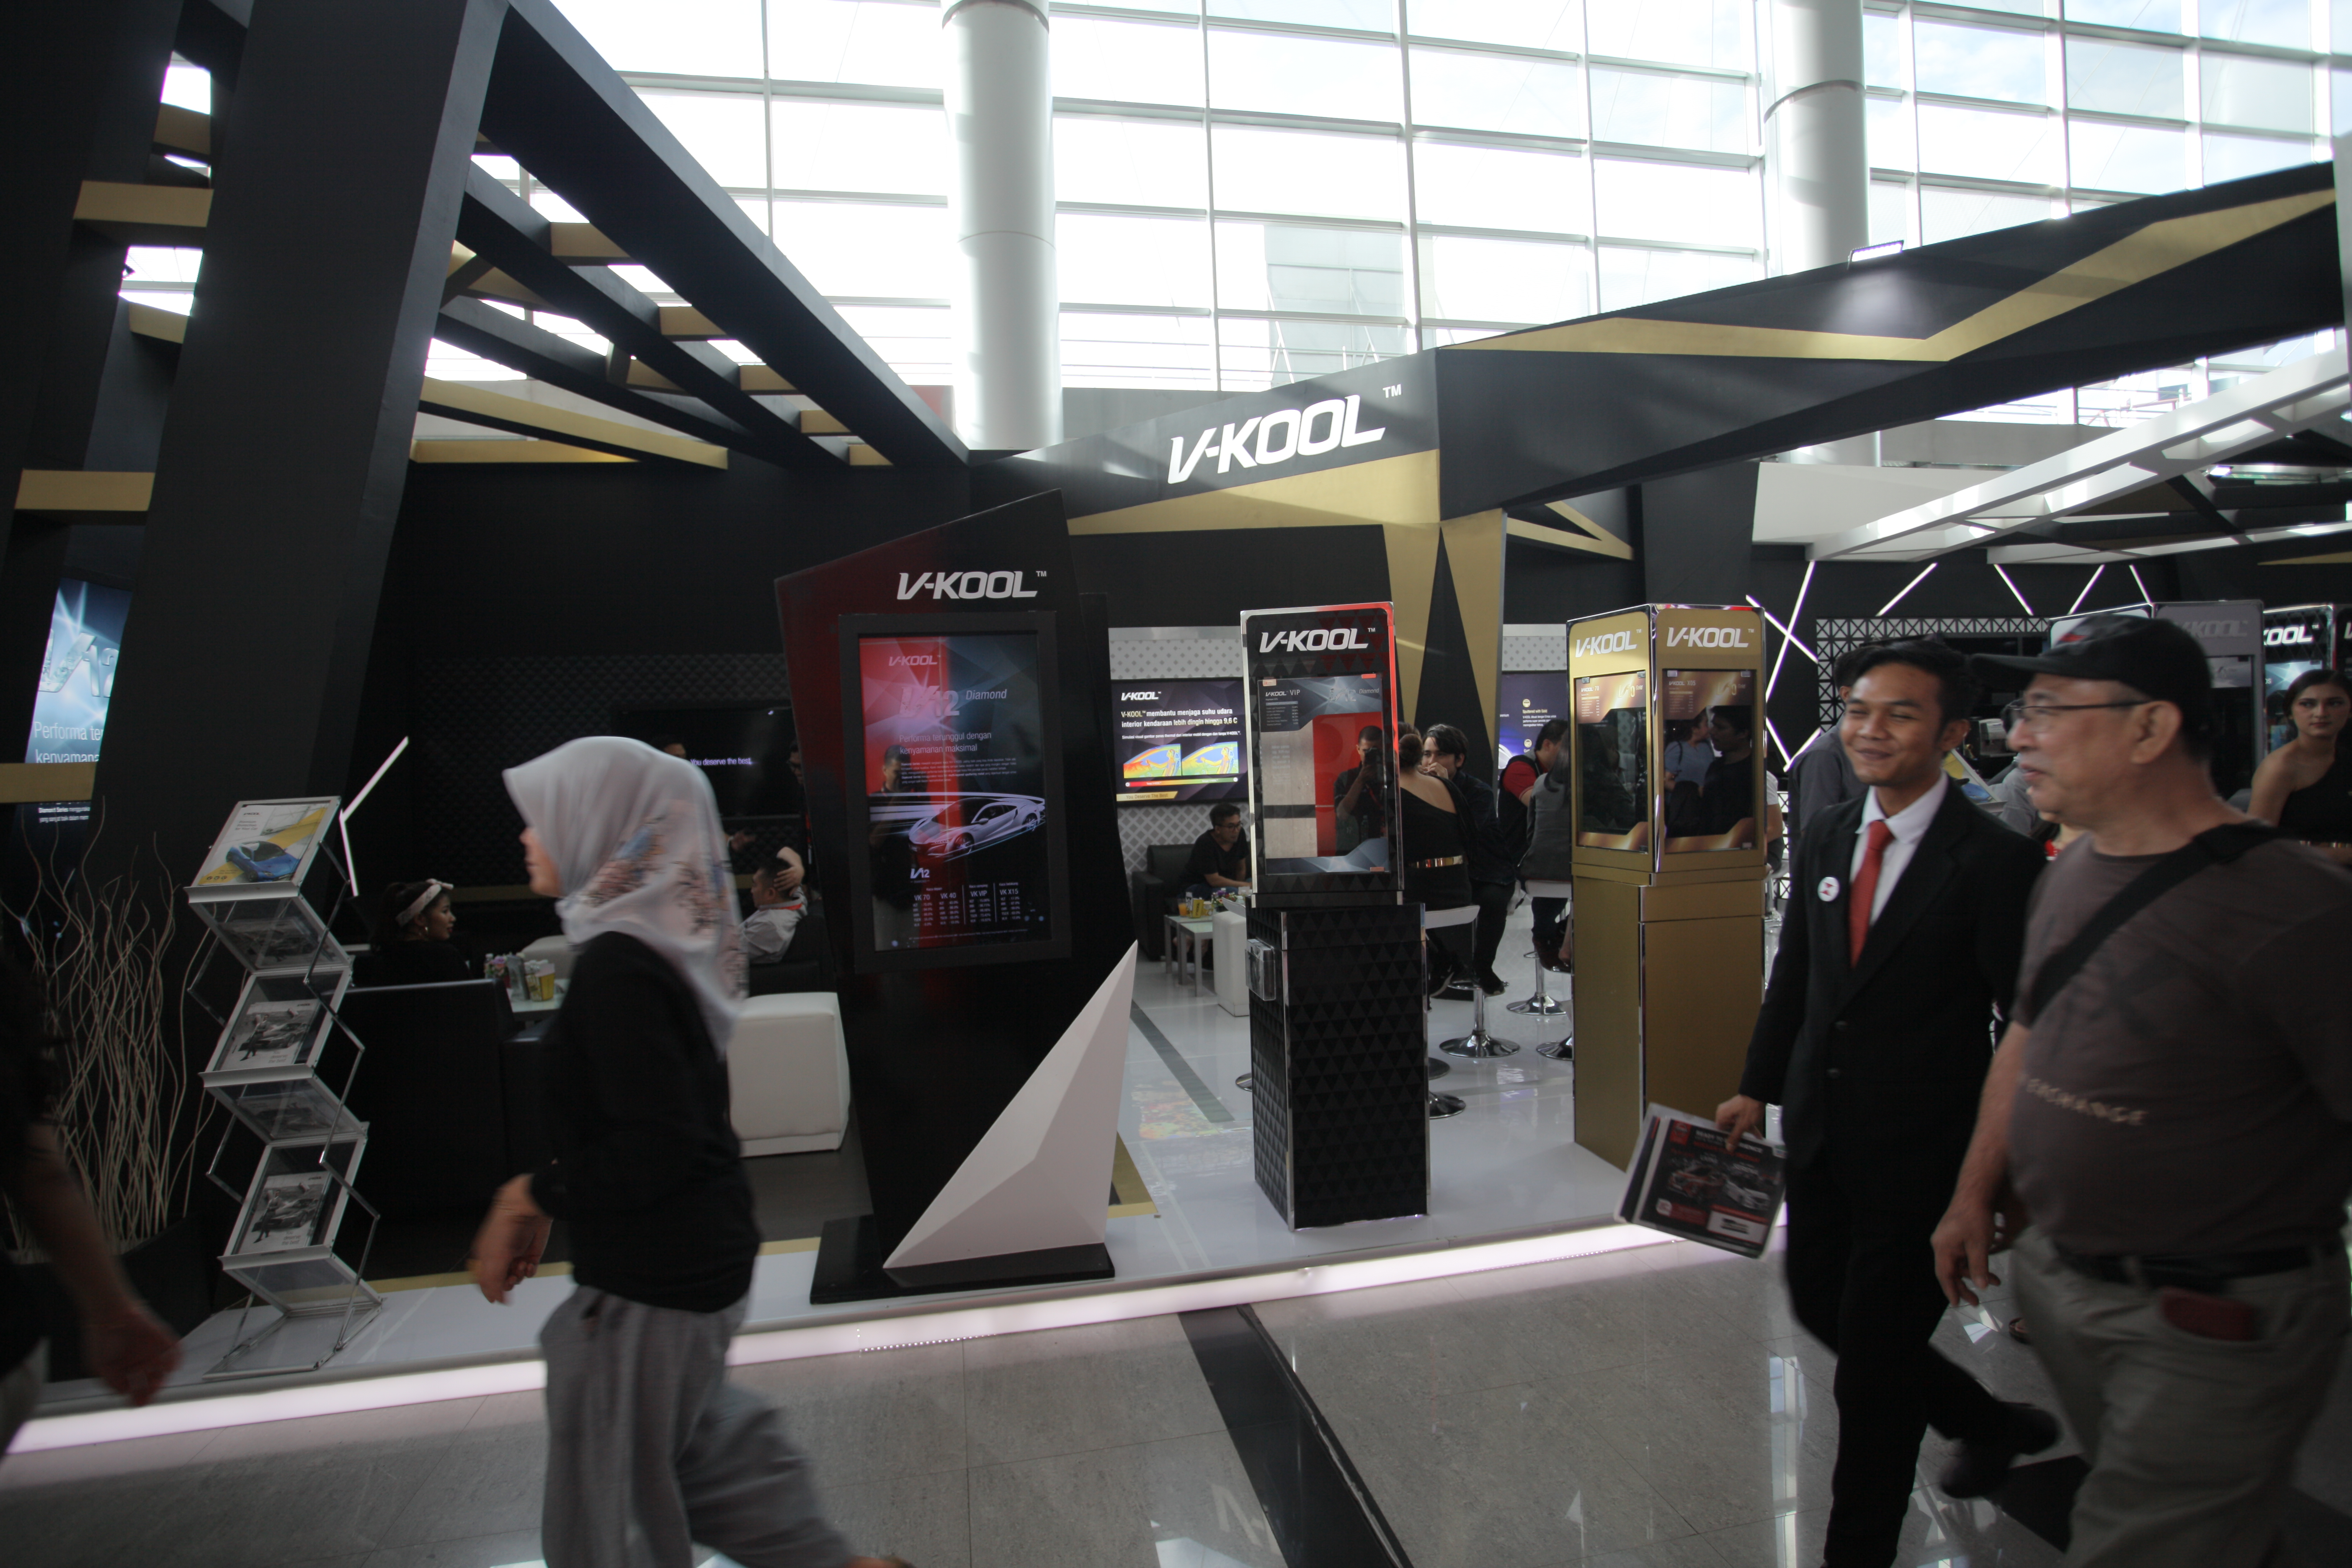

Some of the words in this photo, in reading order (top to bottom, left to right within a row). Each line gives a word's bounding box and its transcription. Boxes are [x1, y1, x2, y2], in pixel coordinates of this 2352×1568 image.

[1168, 394, 1386, 484] V-KOOL
[897, 571, 1037, 600] V-KOOL
[1259, 628, 1369, 652] V-KOOL
[1575, 630, 1637, 658] V-KOOL
[1666, 627, 1749, 648] V-KOOL
[889, 655, 937, 666] V-KOOL
[965, 689, 1007, 700] Diamond
[1121, 691, 1159, 701] V-KOOL
[1205, 717, 1222, 726] hingga
[34, 722, 88, 740] Performa
[933, 732, 965, 742] terunggul
[967, 732, 991, 741] dengan
[900, 747, 943, 756] kenyamanan
